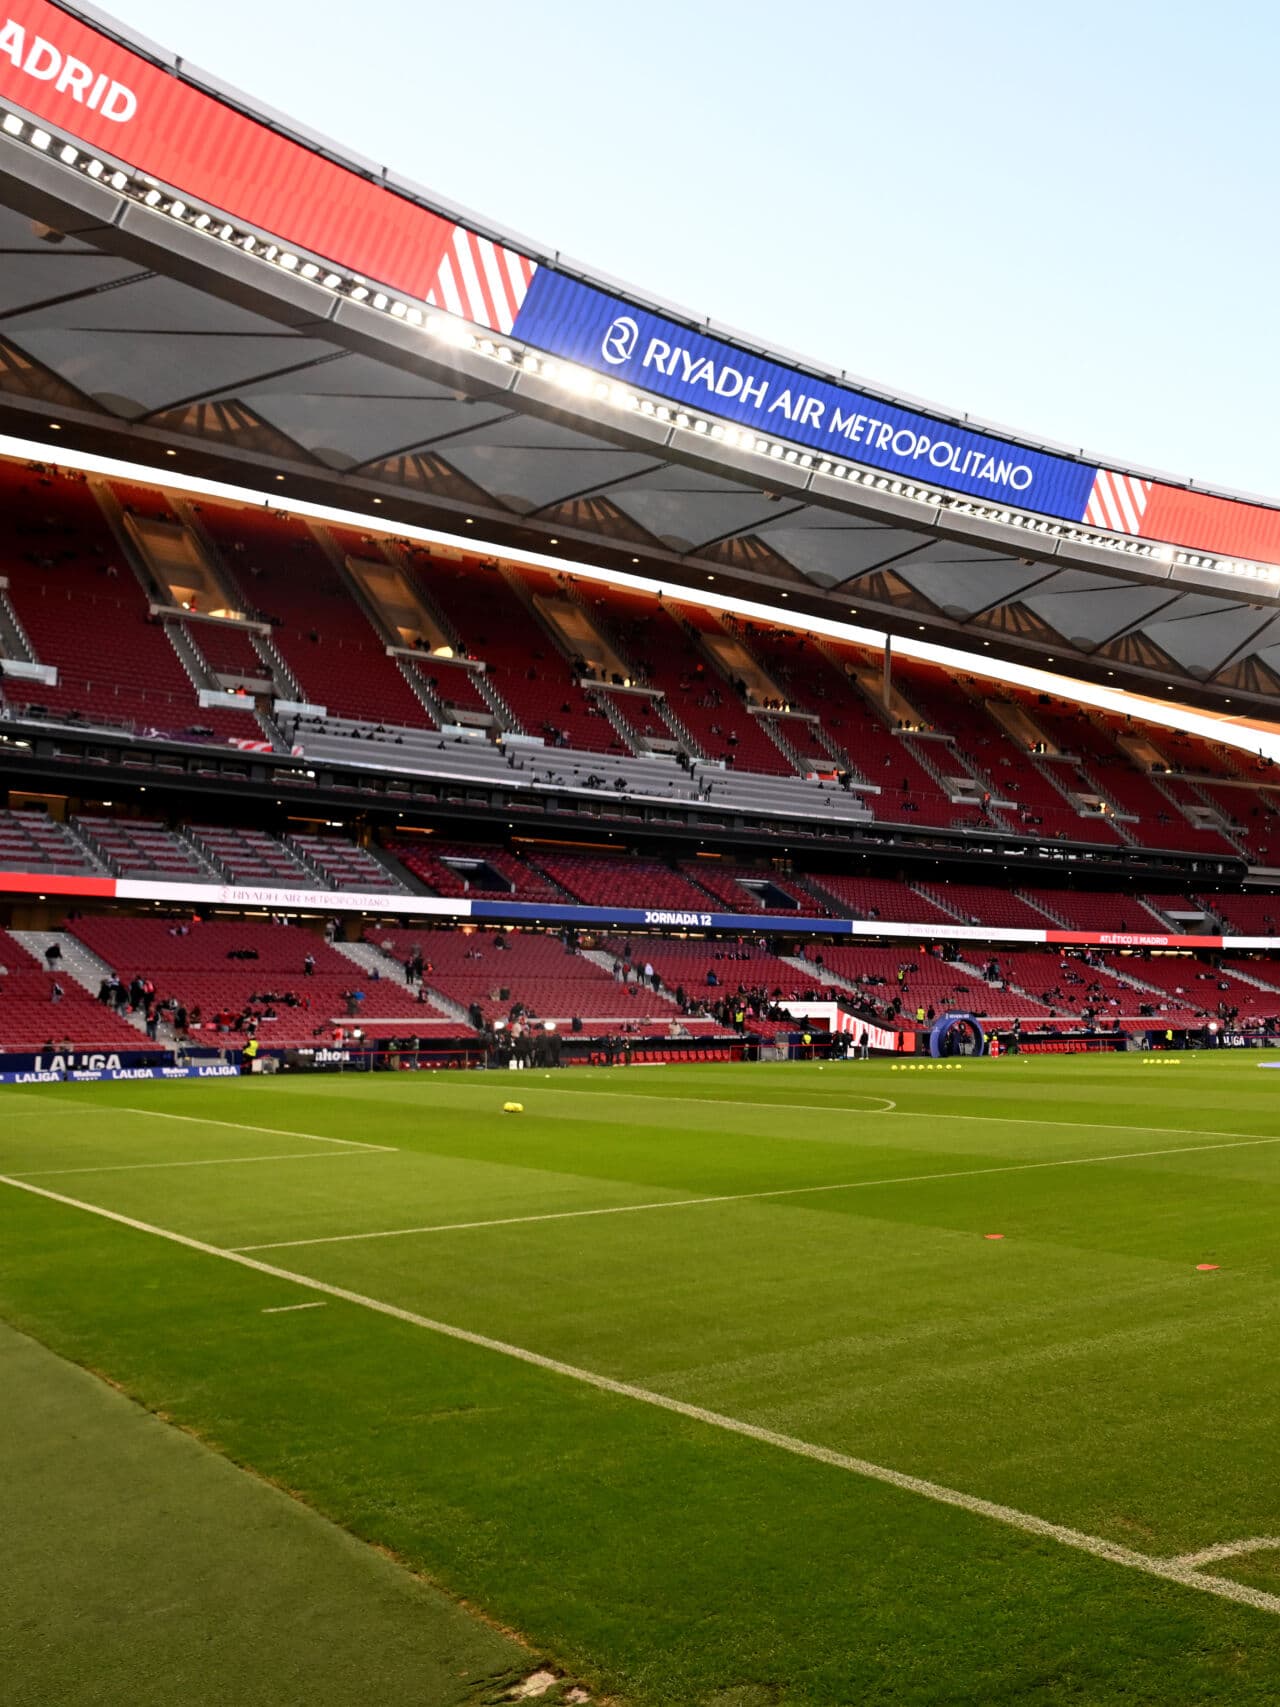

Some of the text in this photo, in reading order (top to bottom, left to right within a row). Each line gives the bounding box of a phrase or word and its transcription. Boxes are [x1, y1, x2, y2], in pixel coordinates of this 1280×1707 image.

[642, 338, 1033, 490] RIYADH AIR METROPOLITANO
[644, 911, 712, 926] JORNADA 12
[1100, 934, 1132, 944] ATLÉTICO
[1139, 936, 1168, 945] MADRID
[112, 1068, 153, 1079] LALIGA
[198, 1066, 238, 1077] LALIGA
[15, 1072, 60, 1084] LALIGA
